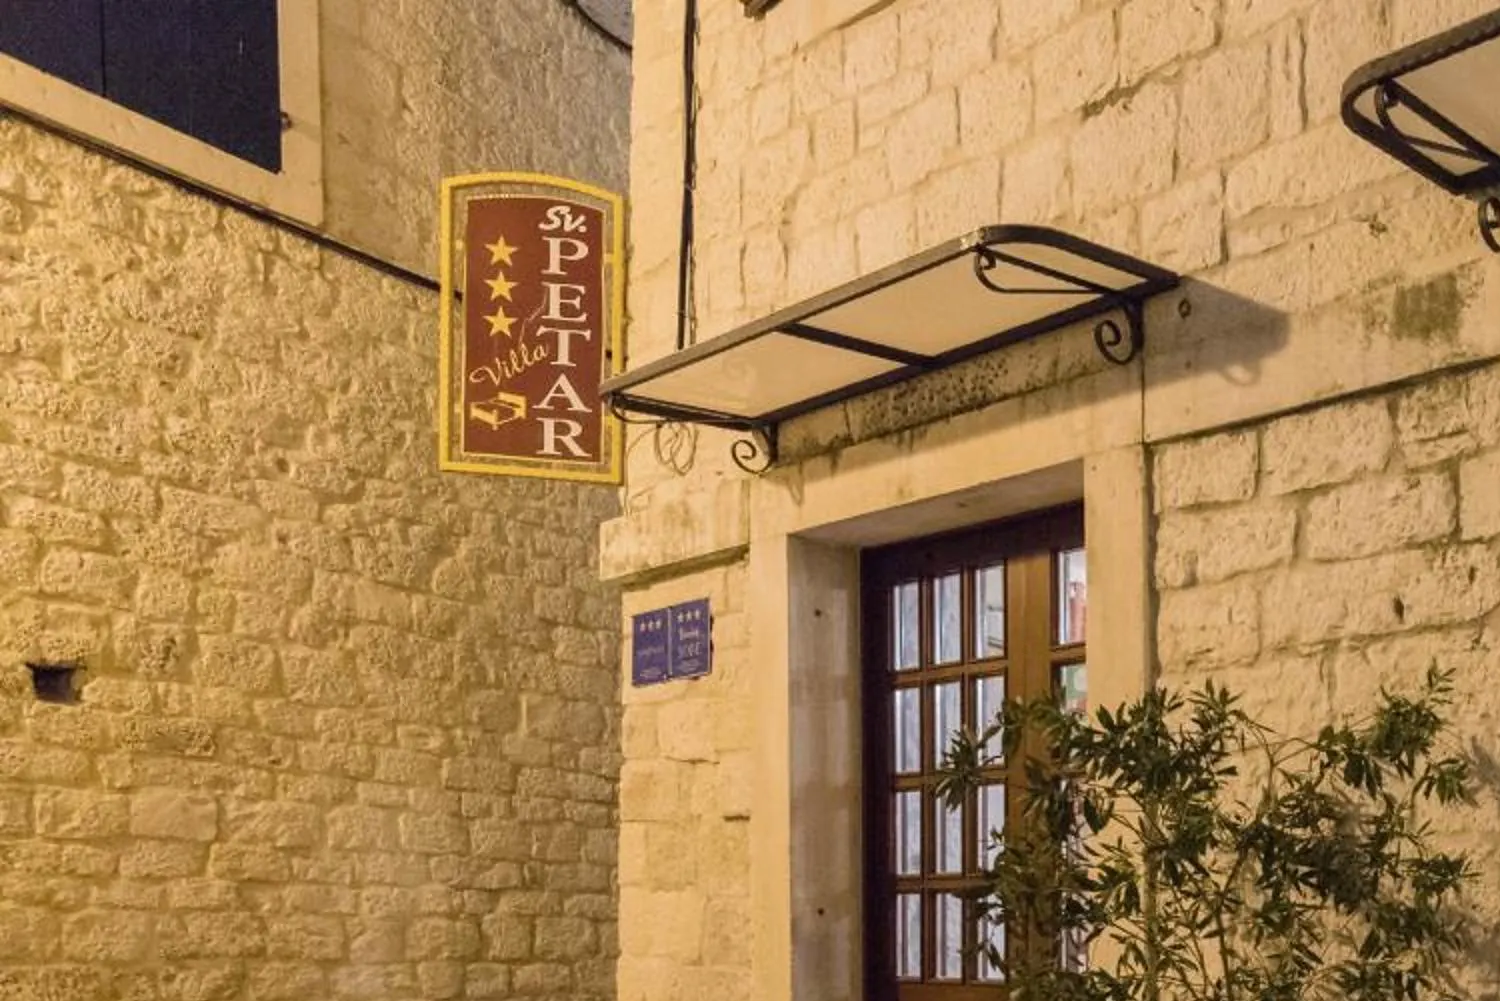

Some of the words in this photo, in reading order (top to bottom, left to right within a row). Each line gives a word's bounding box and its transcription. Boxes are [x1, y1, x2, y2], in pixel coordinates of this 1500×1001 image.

[538, 205, 587, 234] Sv.
[469, 341, 549, 387] Villa
[532, 236, 593, 457] PETAR
